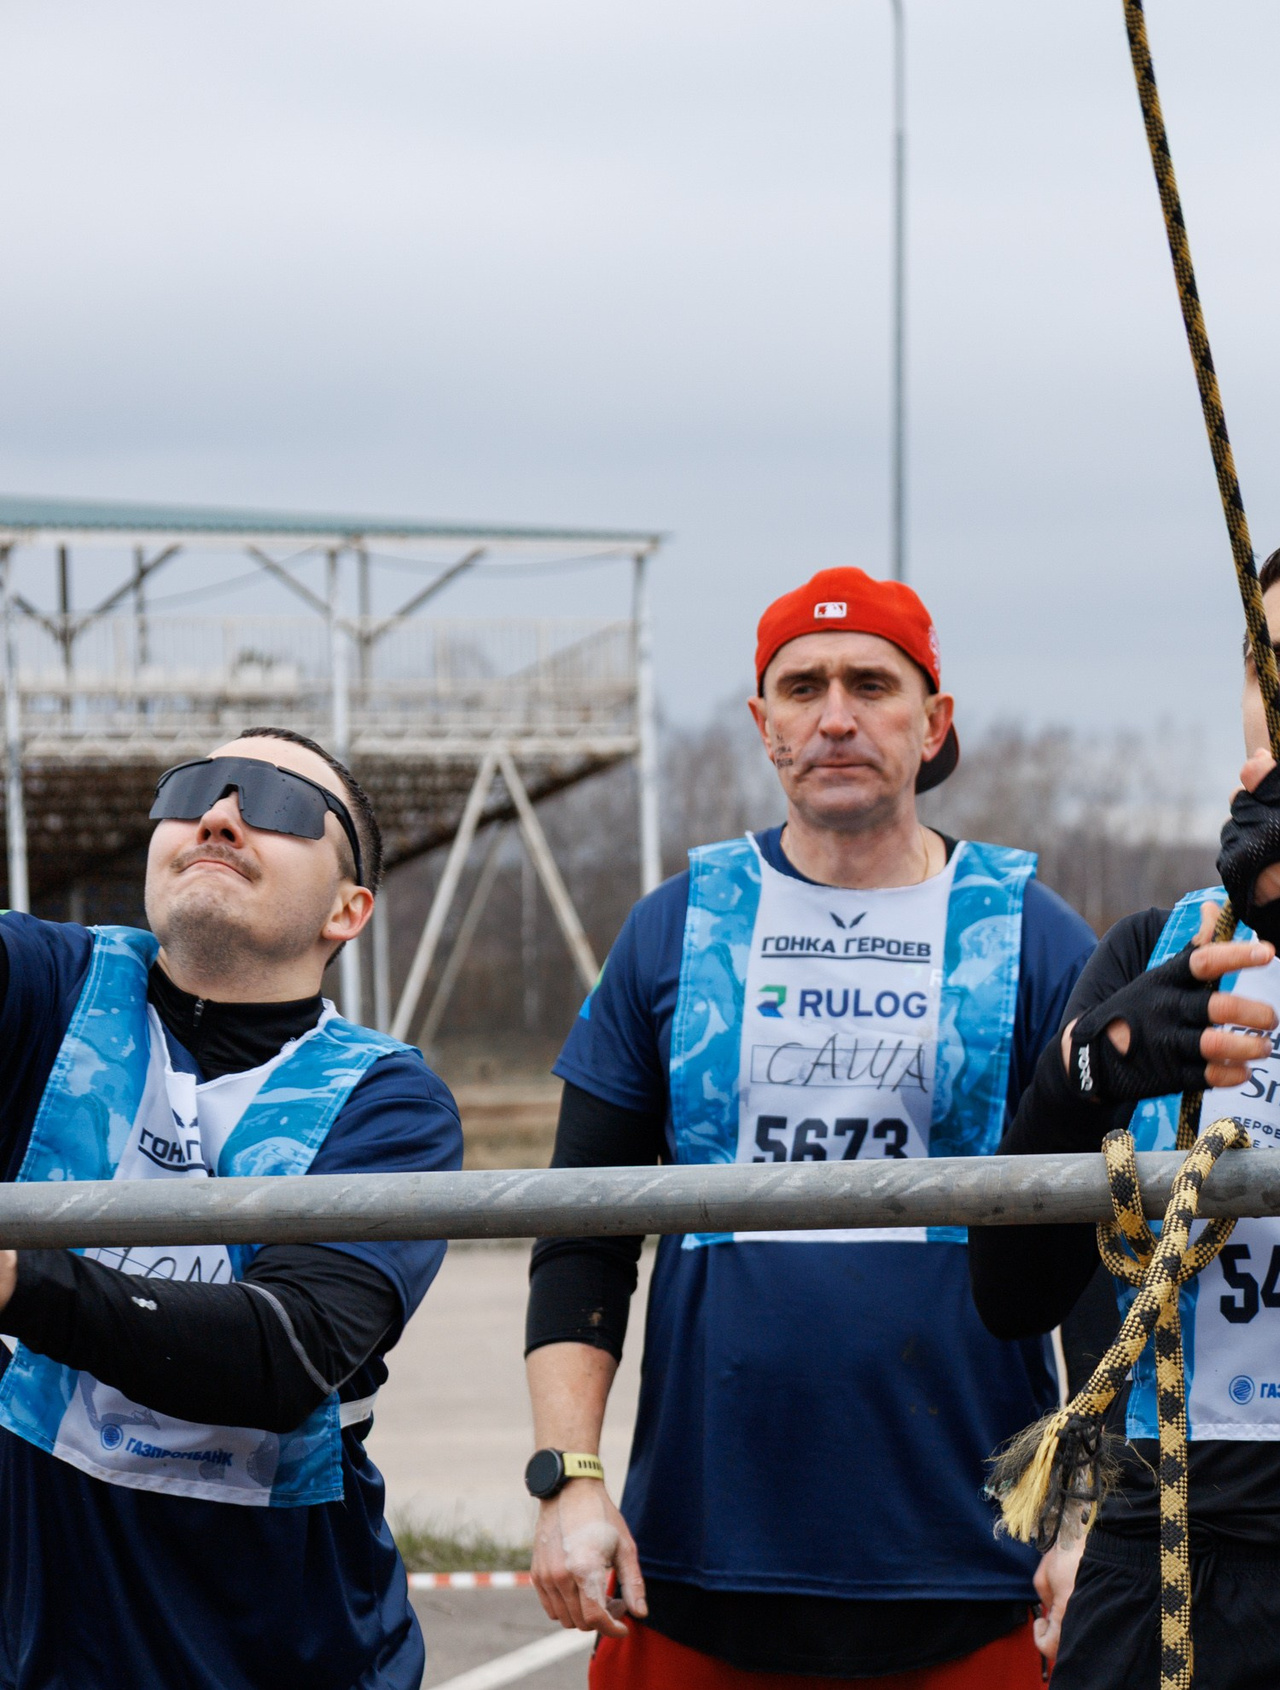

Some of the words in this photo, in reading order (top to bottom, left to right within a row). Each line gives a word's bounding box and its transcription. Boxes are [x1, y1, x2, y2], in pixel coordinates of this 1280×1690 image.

[761, 935, 836, 954] ГОНКА
[844, 937, 932, 957] ГЕРОЕВ
[798, 988, 929, 1019] RULOG
[766, 1032, 929, 1094] САША
[752, 1114, 909, 1163] 5673
[125, 1437, 233, 1467] ГАЗПРОМБАНК
